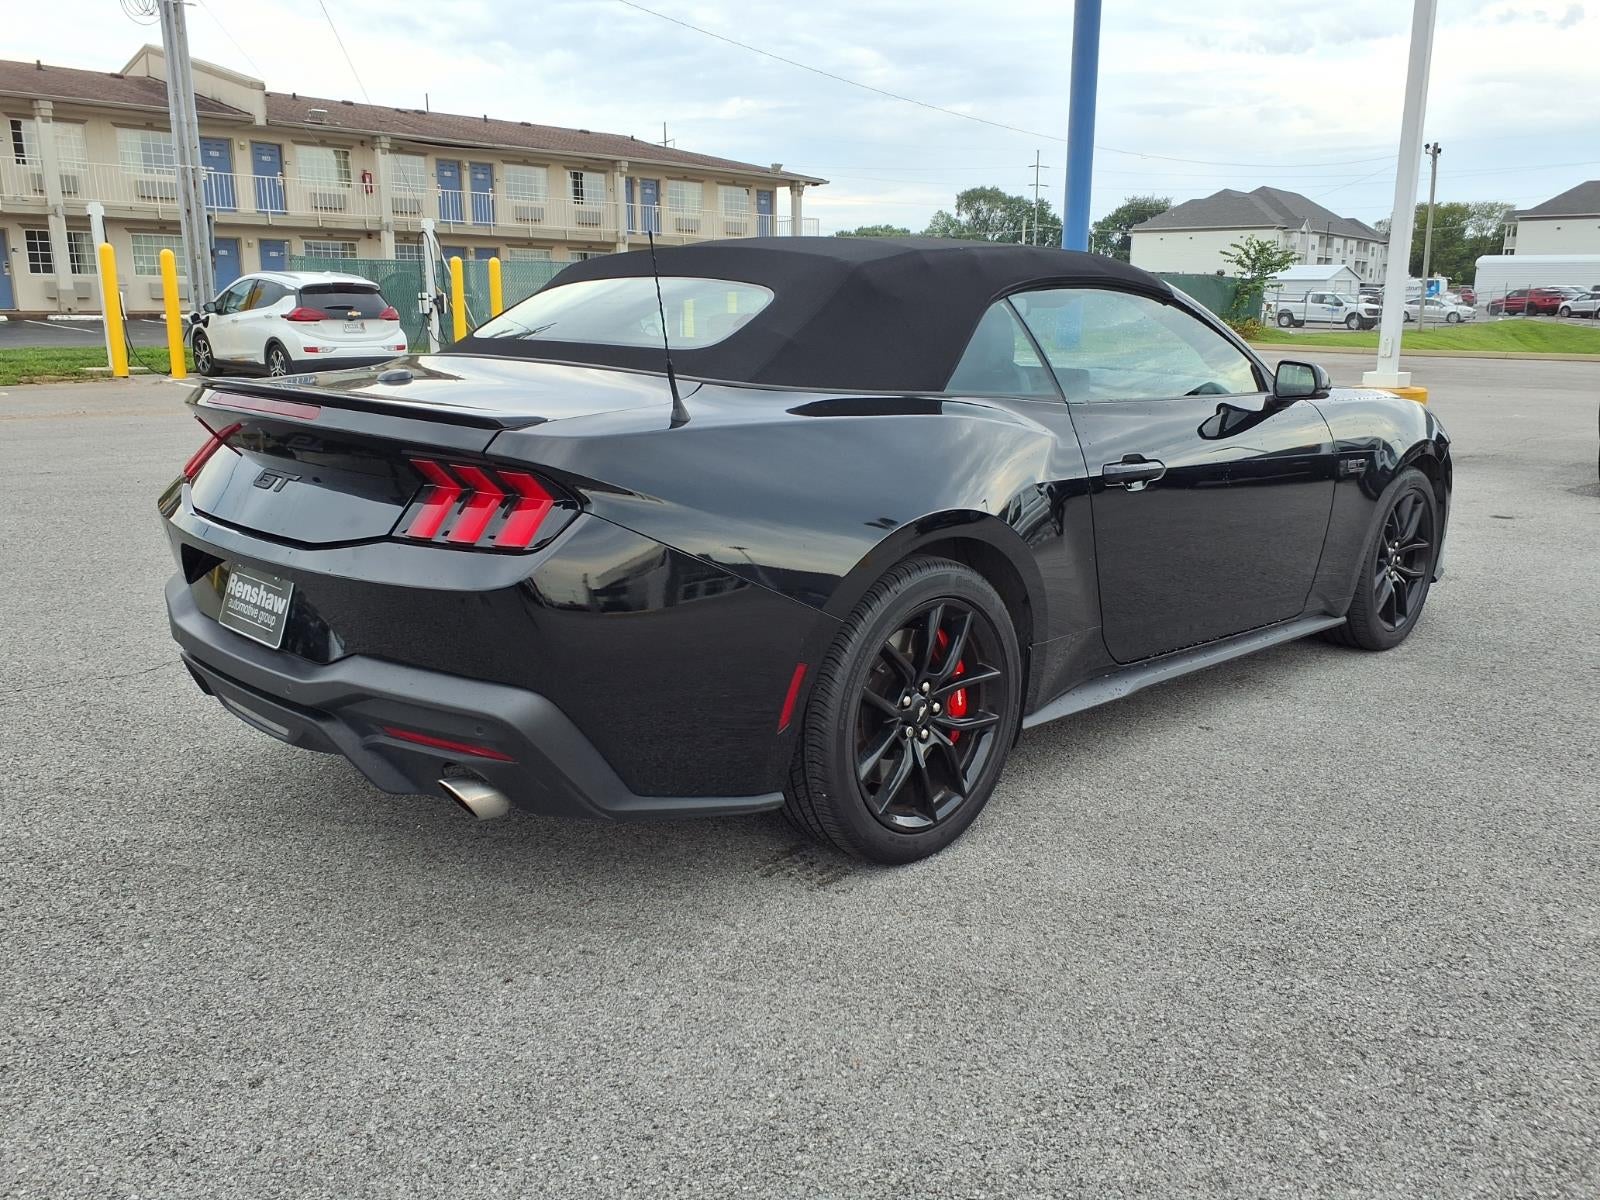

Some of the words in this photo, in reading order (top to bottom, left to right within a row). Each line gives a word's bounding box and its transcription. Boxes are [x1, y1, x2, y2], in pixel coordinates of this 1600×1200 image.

[253, 467, 302, 492] GT
[228, 573, 287, 614] Renshaw
[228, 598, 259, 618] automotive
[257, 611, 276, 627] group
